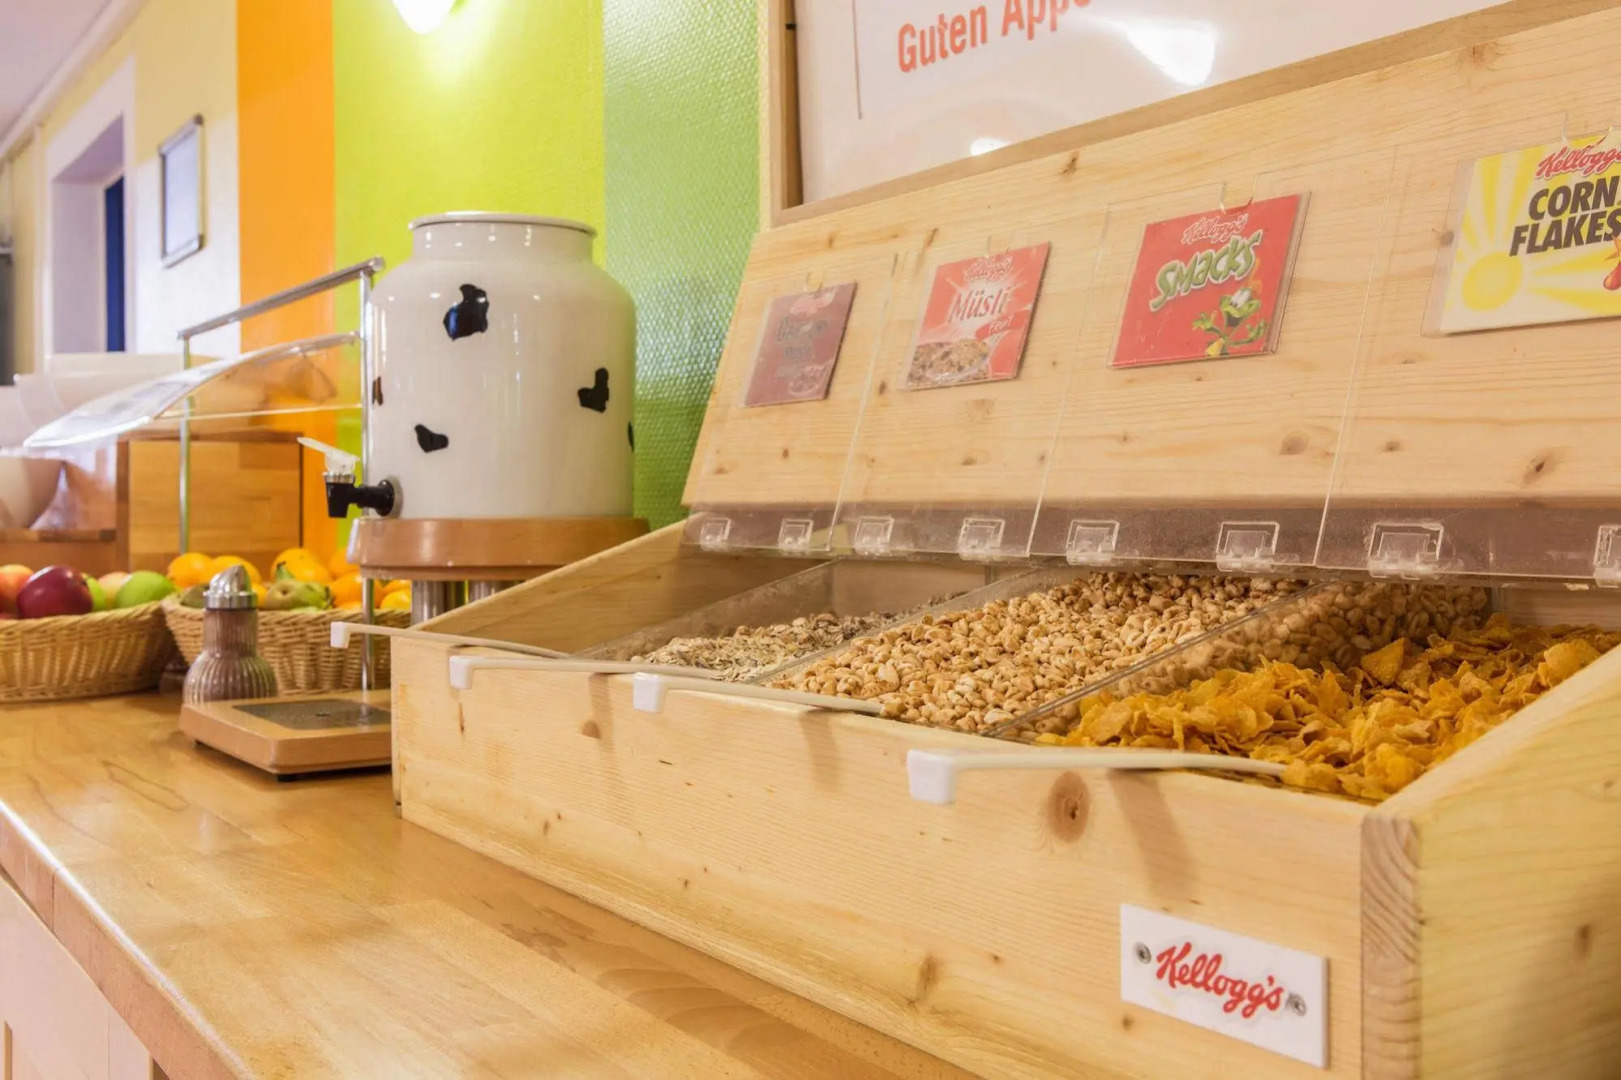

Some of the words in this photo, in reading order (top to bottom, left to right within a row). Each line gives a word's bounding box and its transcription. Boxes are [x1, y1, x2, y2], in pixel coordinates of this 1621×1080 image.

[897, 4, 988, 73] Guten
[1001, 0, 1091, 40] App
[1535, 145, 1621, 179] Kellogg
[1529, 175, 1620, 221] CORN
[1509, 208, 1621, 257] FLAKES
[948, 286, 1012, 323] Müsli
[1156, 942, 1284, 1019] Kellogg's
